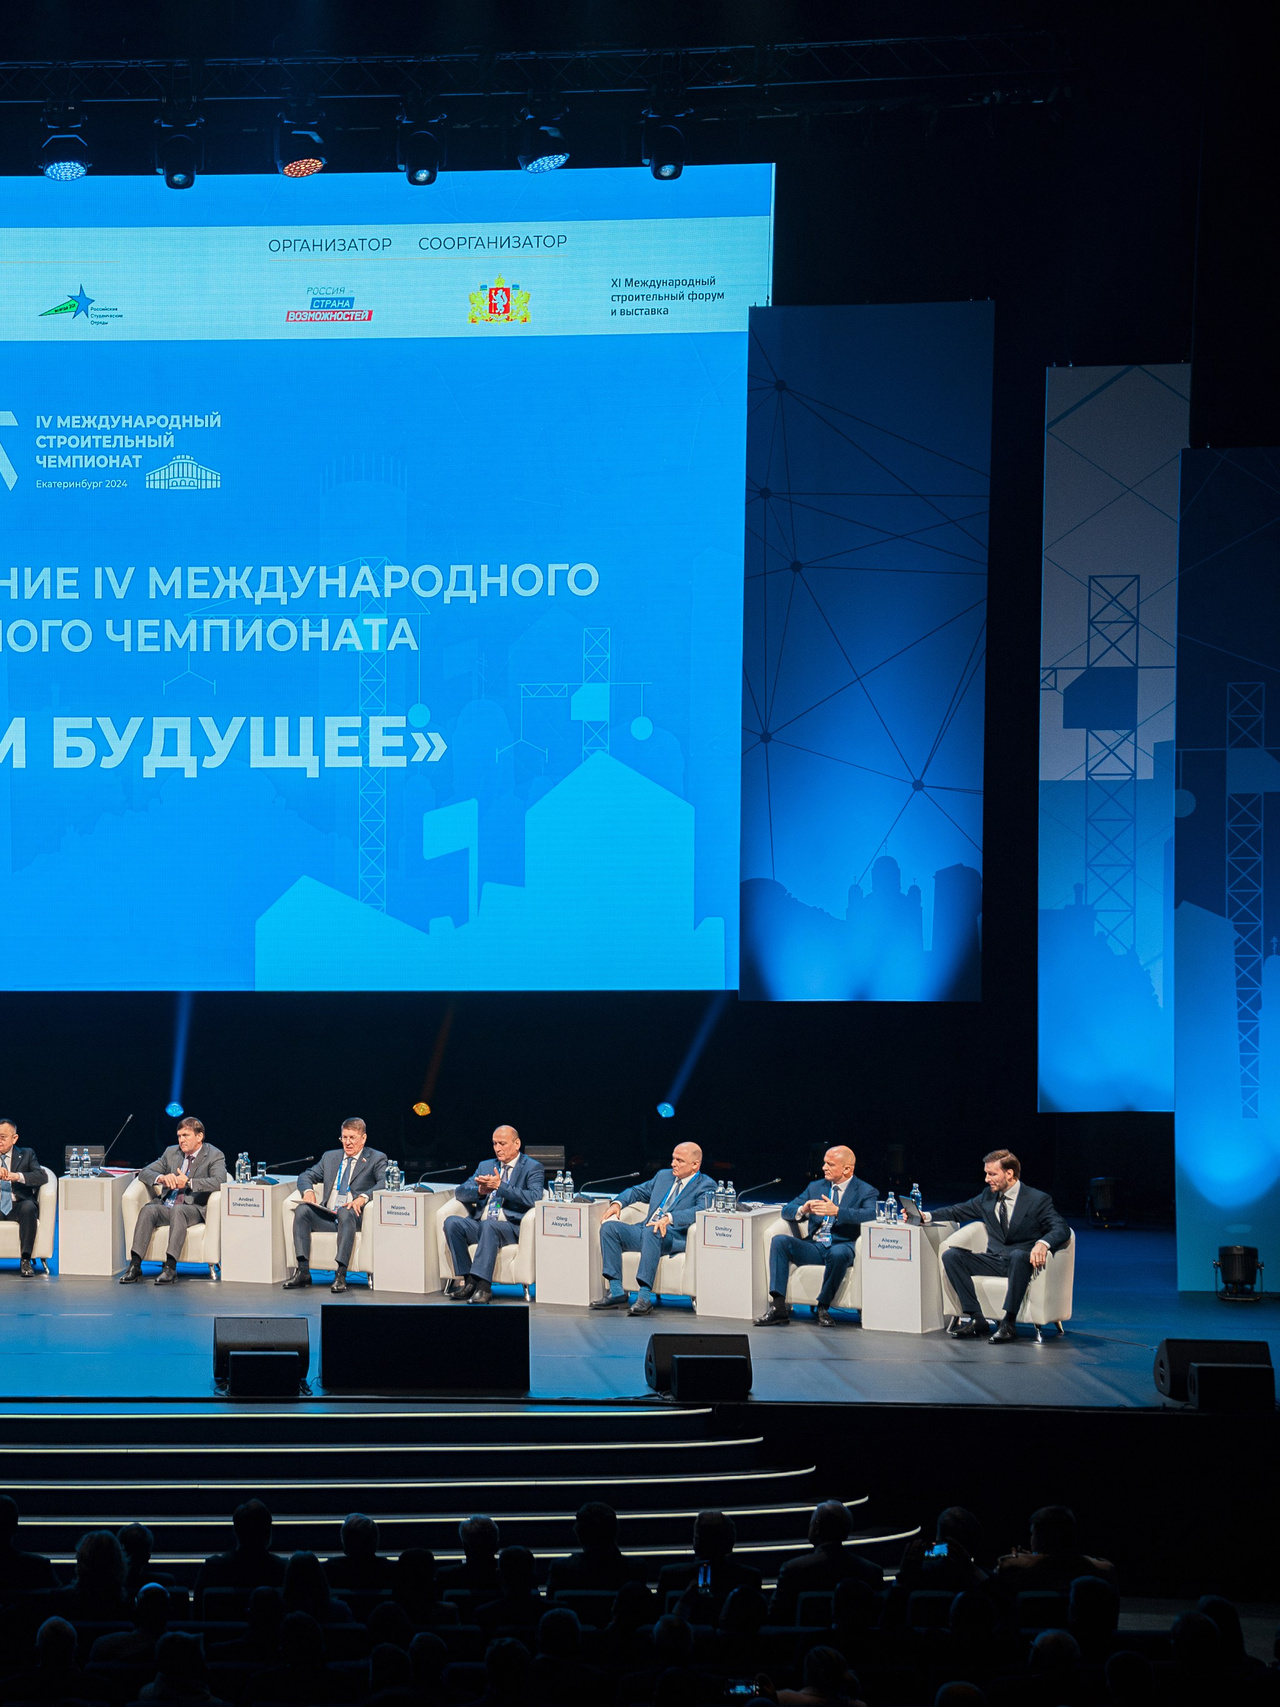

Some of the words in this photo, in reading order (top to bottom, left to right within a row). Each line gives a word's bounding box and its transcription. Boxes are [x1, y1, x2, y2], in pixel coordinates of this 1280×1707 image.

[268, 239, 392, 252] ОРГАНИЗАТОР
[418, 235, 568, 250] СООРГАНИЗАТОР
[624, 277, 716, 288] Международный
[307, 287, 345, 295] РОССИЯ
[611, 292, 685, 303] строительный
[688, 291, 725, 302] форум
[313, 299, 350, 308] СТРАНА
[288, 310, 369, 321] ВОЗМОЖНОСТЕЙ
[620, 308, 669, 316] выставка
[36, 415, 52, 428] IV
[57, 411, 221, 431] МЕЖДУНАРОДНЫЙ
[36, 431, 175, 449] СТРОИТЕЛЬНЫЙ
[36, 454, 143, 469] ЧЕМПИОНАТ
[36, 479, 103, 489] Екатеринбург
[105, 479, 128, 488] 2024
[94, 567, 134, 599] IV
[146, 562, 600, 601] МЕЖДУНАРОДНОГО
[105, 616, 419, 652] ЧЕМПИОНАТА
[52, 716, 448, 779] БУДУЩЕЕ»
